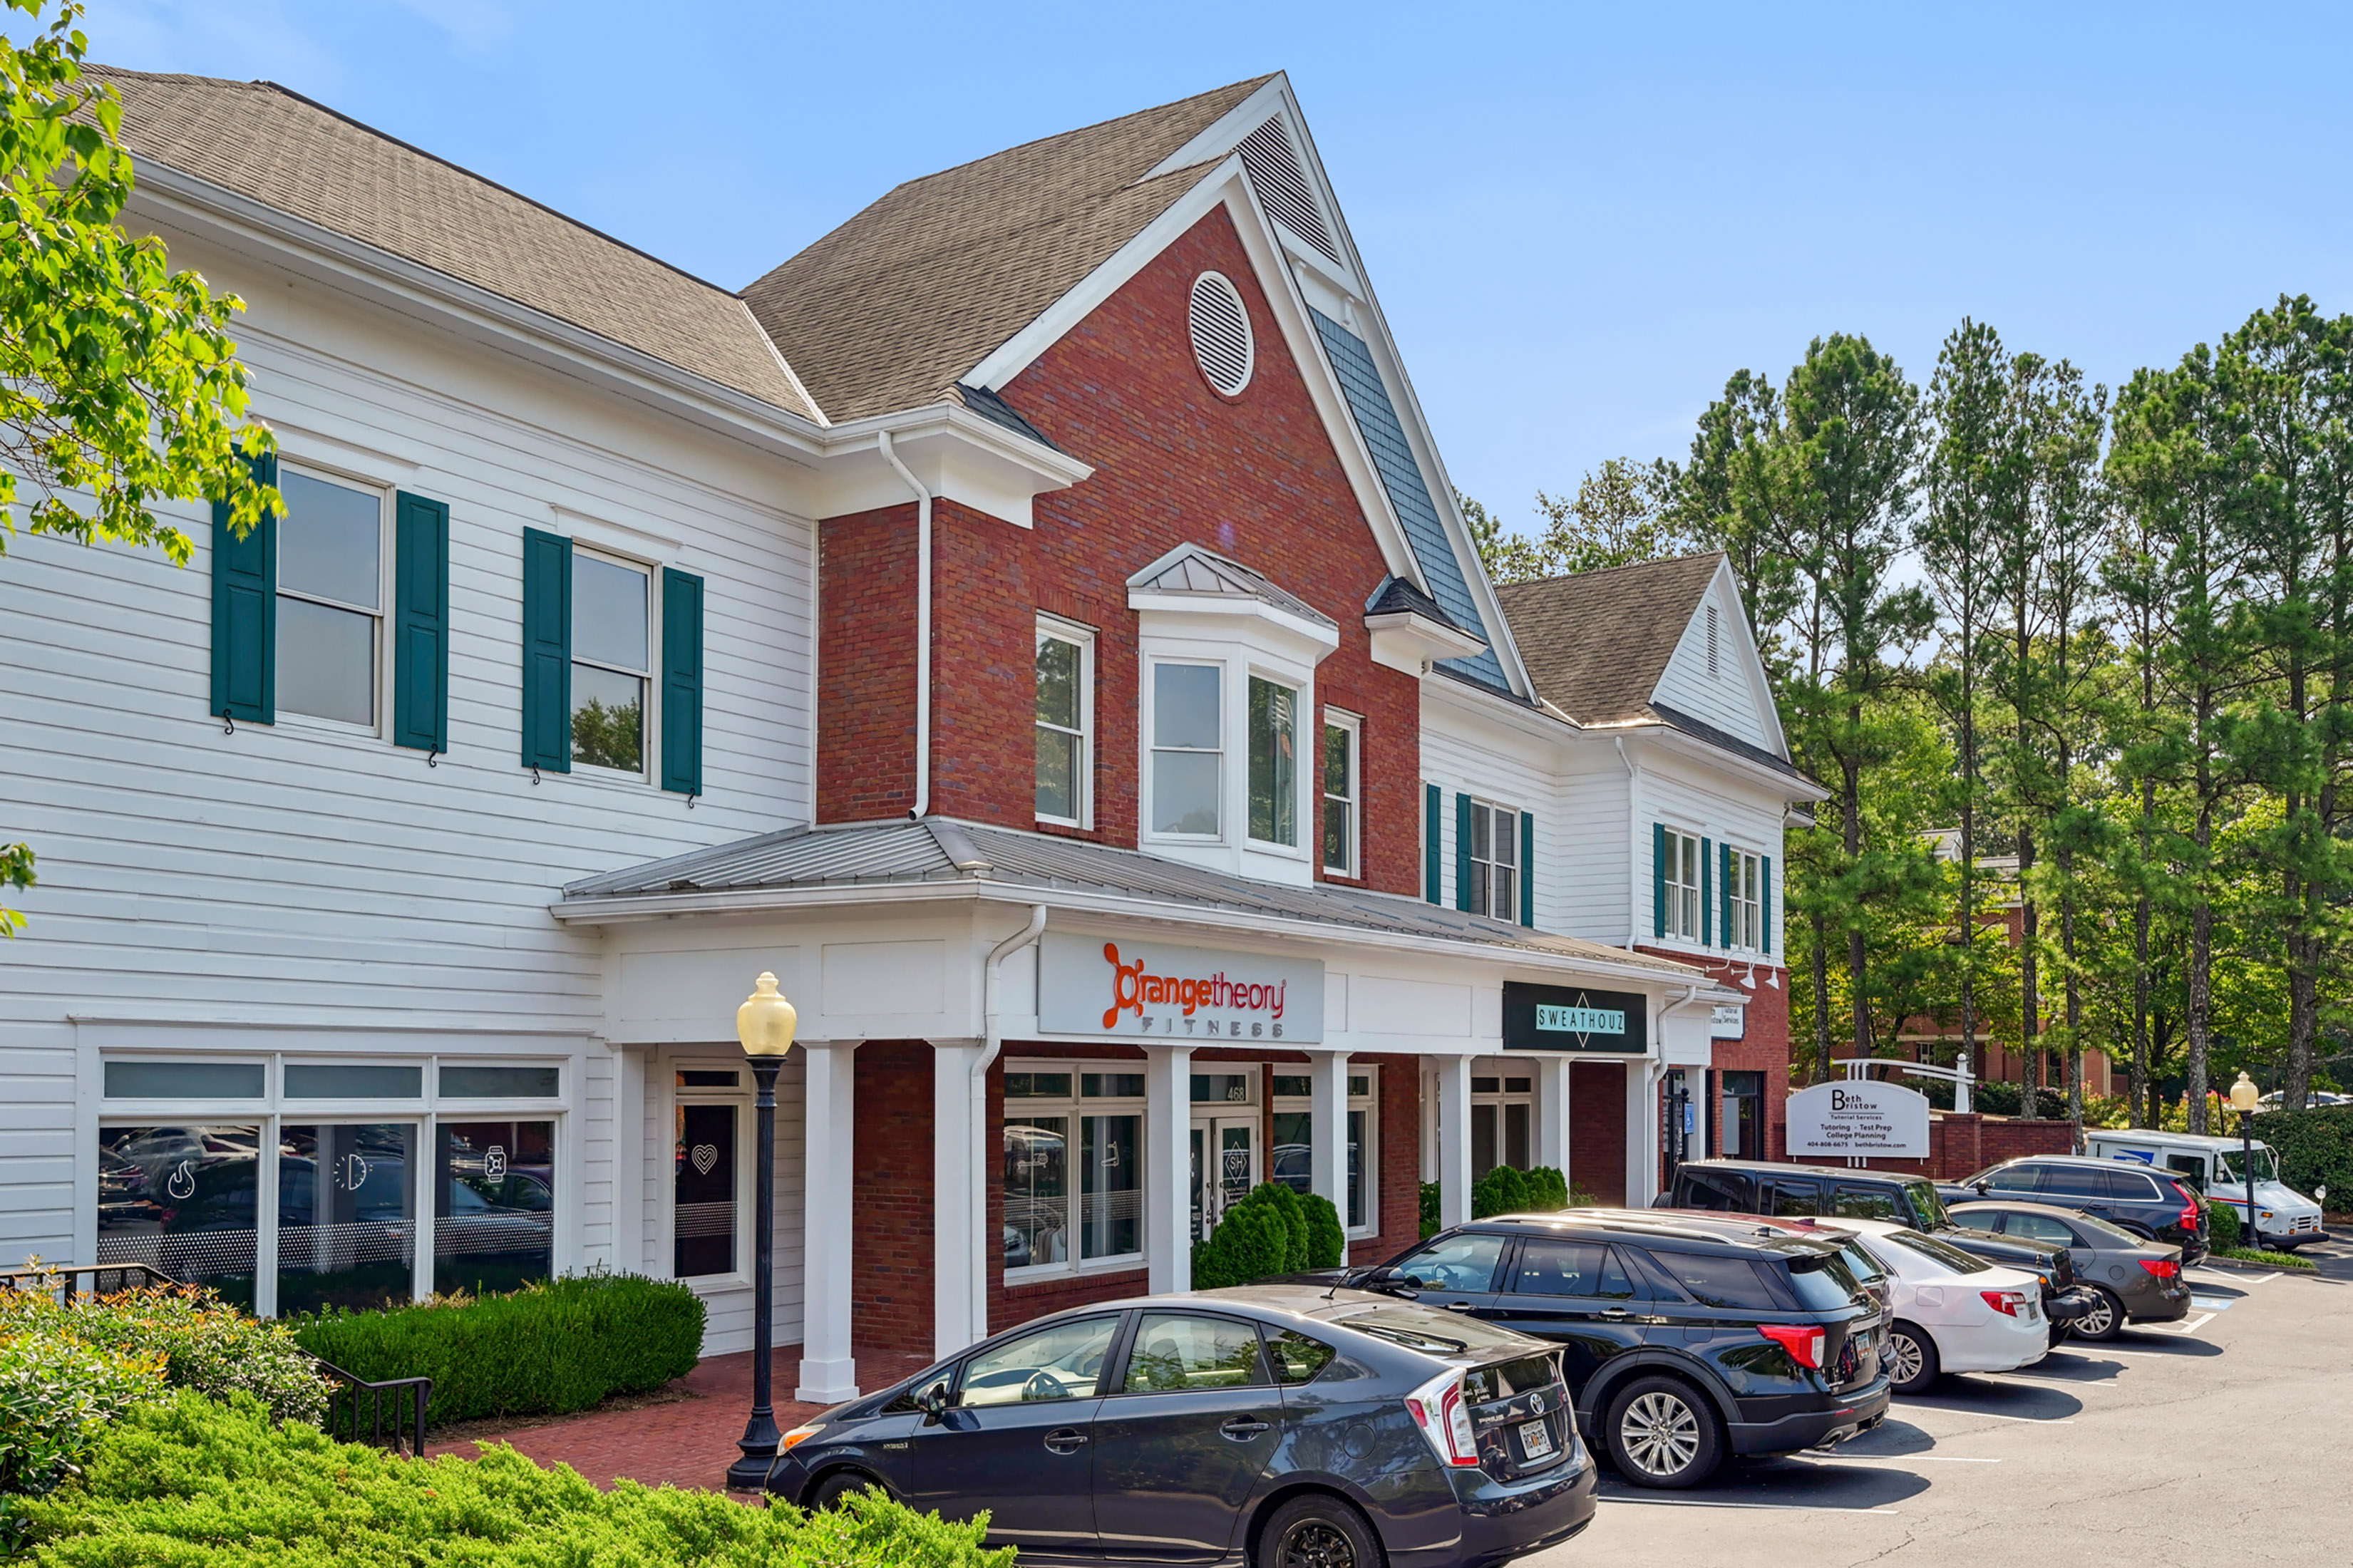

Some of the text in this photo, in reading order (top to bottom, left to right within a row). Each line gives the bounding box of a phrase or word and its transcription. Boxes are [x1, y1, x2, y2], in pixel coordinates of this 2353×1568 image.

[1142, 1016, 1283, 1037] FITNESS
[1538, 1009, 1623, 1030] SWEATHOUZ
[1227, 1086, 1245, 1100] 468
[1832, 1089, 1862, 1110] Beth
[1854, 1132, 1886, 1140] Planning
